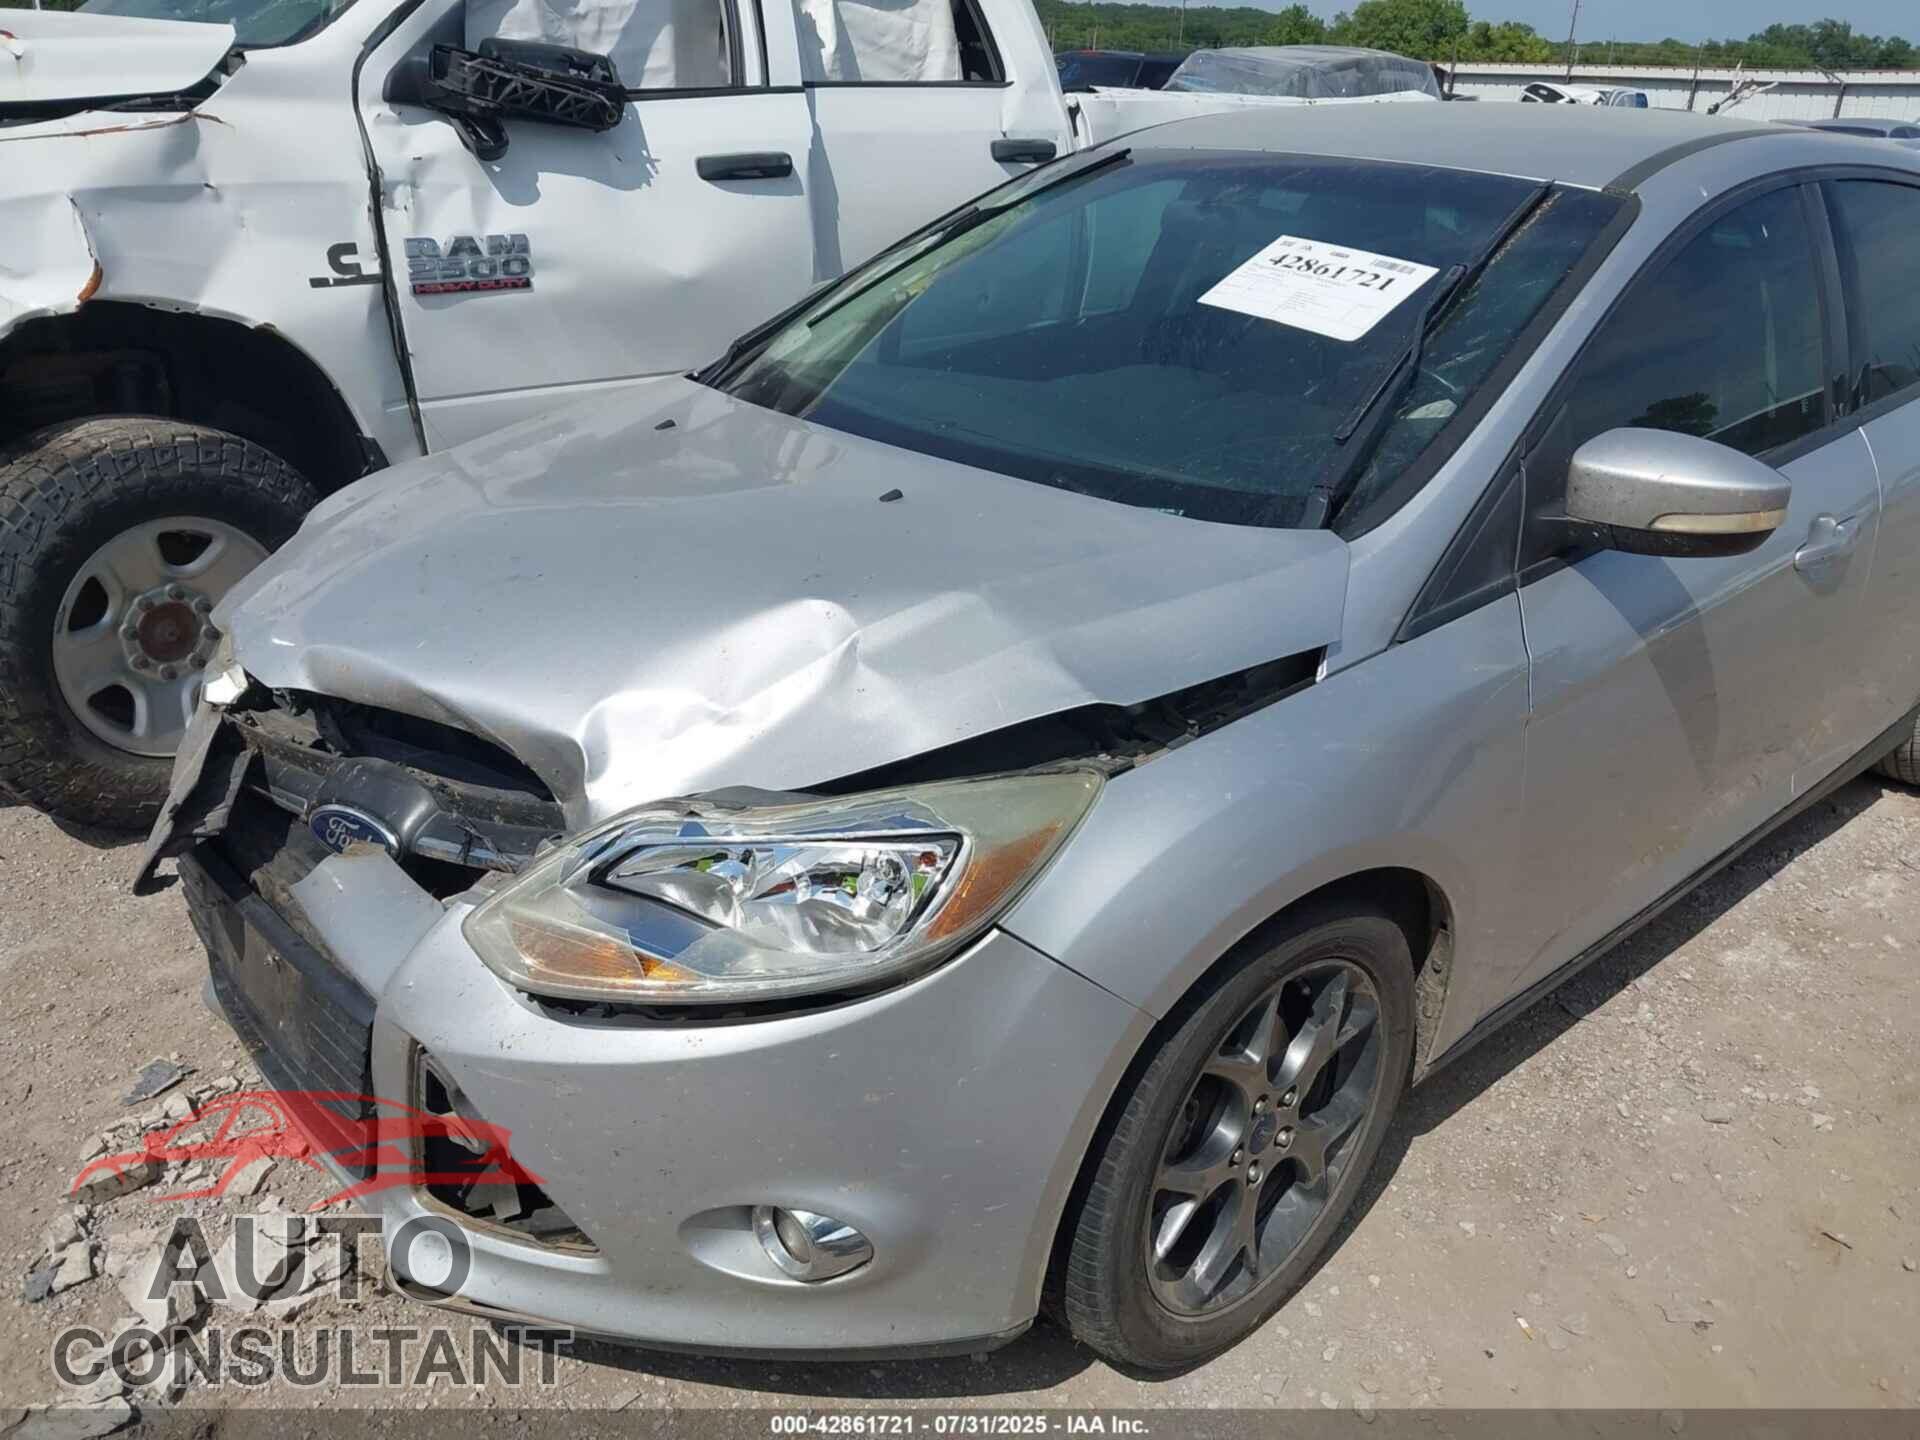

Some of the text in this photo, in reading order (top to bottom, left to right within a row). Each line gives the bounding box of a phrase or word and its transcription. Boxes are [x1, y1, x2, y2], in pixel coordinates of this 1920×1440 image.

[404, 234, 531, 258] RAM
[407, 254, 531, 281] 2500
[1269, 253, 1396, 291] 42861721
[413, 278, 527, 294] HEAVY DUTY
